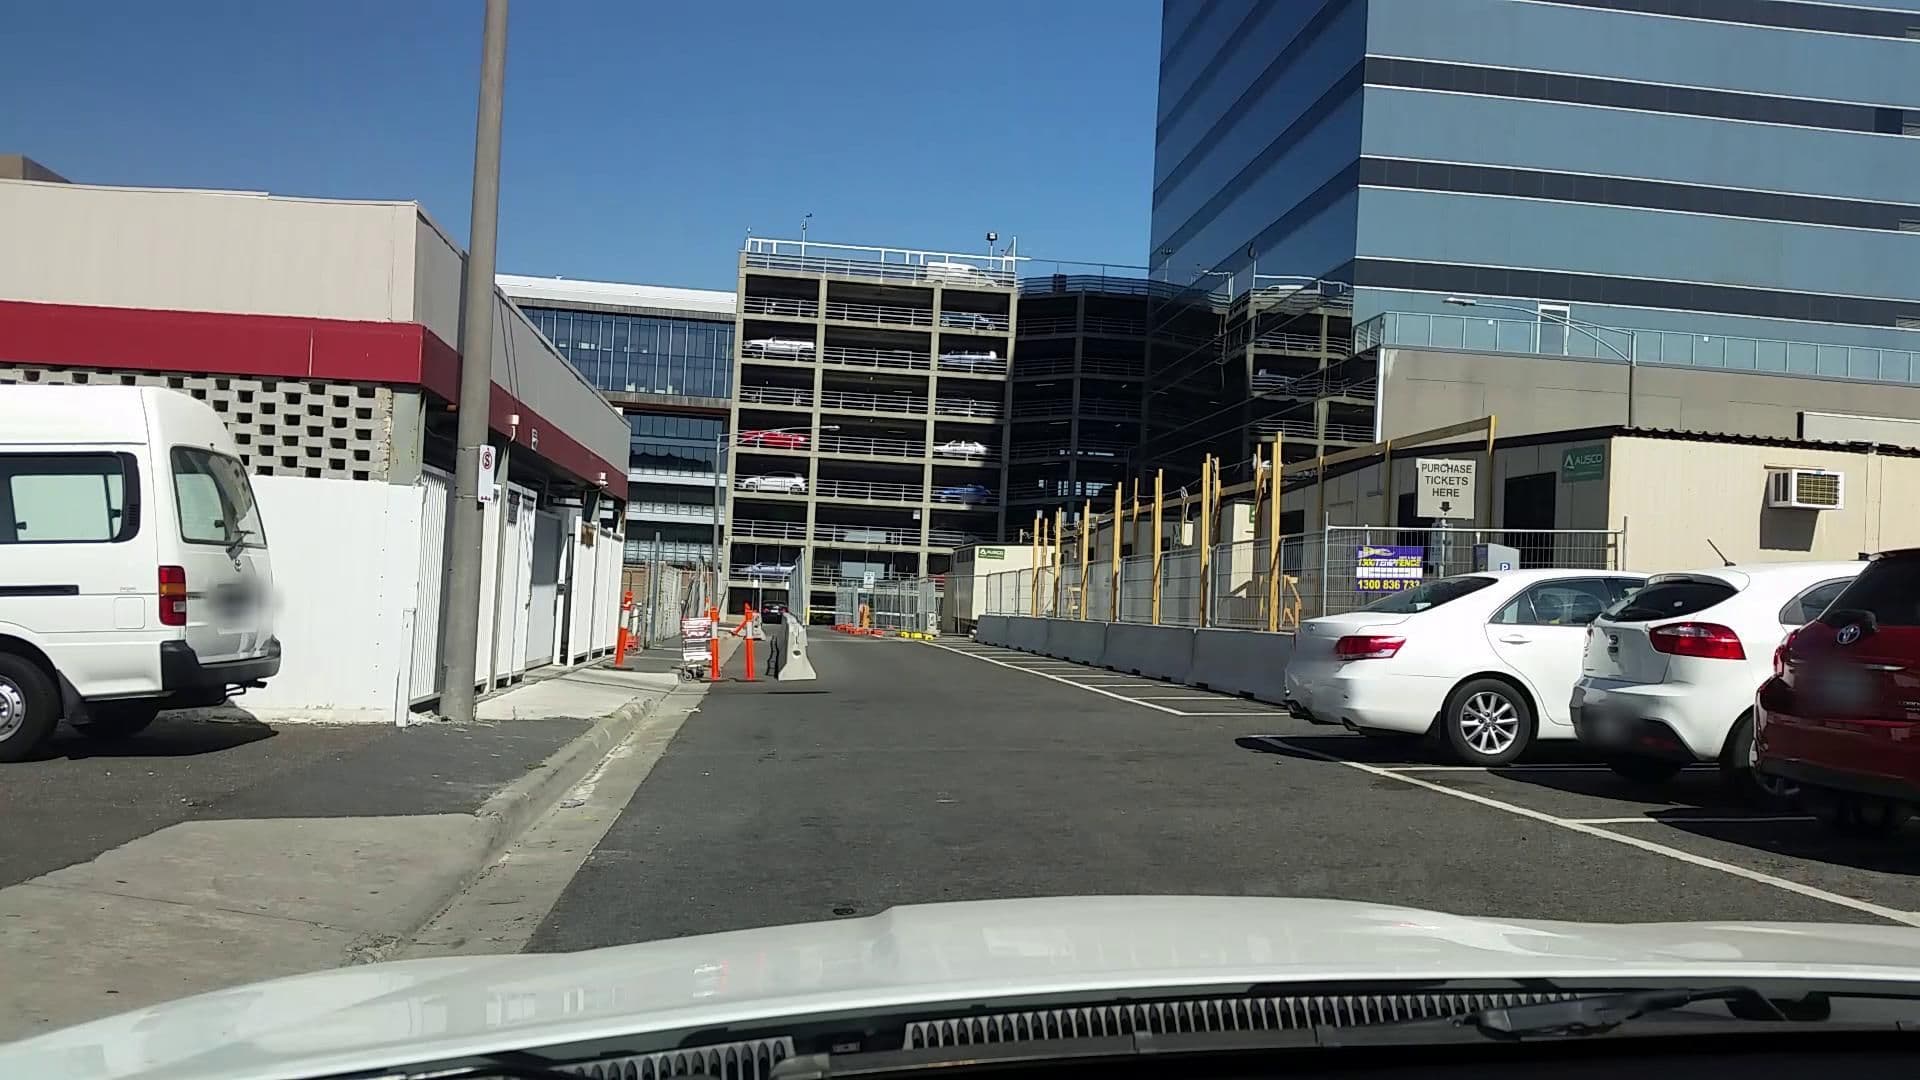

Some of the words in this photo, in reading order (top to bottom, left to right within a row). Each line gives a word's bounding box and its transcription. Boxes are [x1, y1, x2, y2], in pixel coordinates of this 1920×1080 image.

[1574, 453, 1603, 465] AUSCO
[1421, 463, 1473, 474] PURCHASE
[1424, 475, 1469, 486] TICKETS
[1432, 487, 1460, 498] HERE
[1358, 579, 1380, 590] 1300
[1383, 580, 1401, 590] 836
